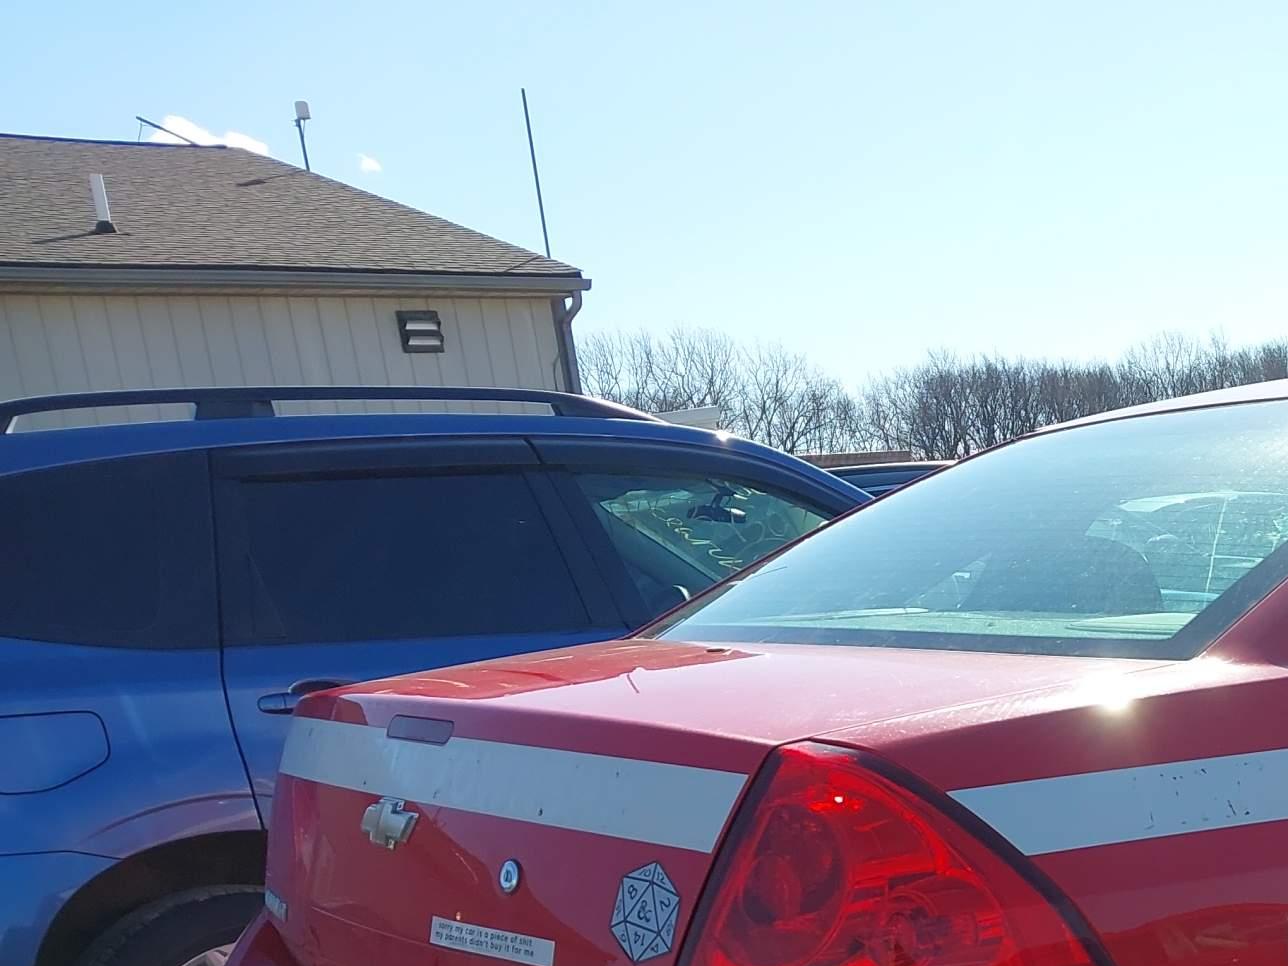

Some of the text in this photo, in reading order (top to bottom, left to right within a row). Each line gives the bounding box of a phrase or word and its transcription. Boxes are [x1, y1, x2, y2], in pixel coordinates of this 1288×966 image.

[438, 922, 453, 933] sorry
[465, 928, 476, 936] car
[490, 932, 506, 942] piece
[519, 936, 533, 947] shit
[444, 933, 468, 945] parents
[469, 937, 489, 949] didn't
[489, 940, 502, 953] buy
[511, 944, 522, 955] for
[523, 947, 534, 957] me
